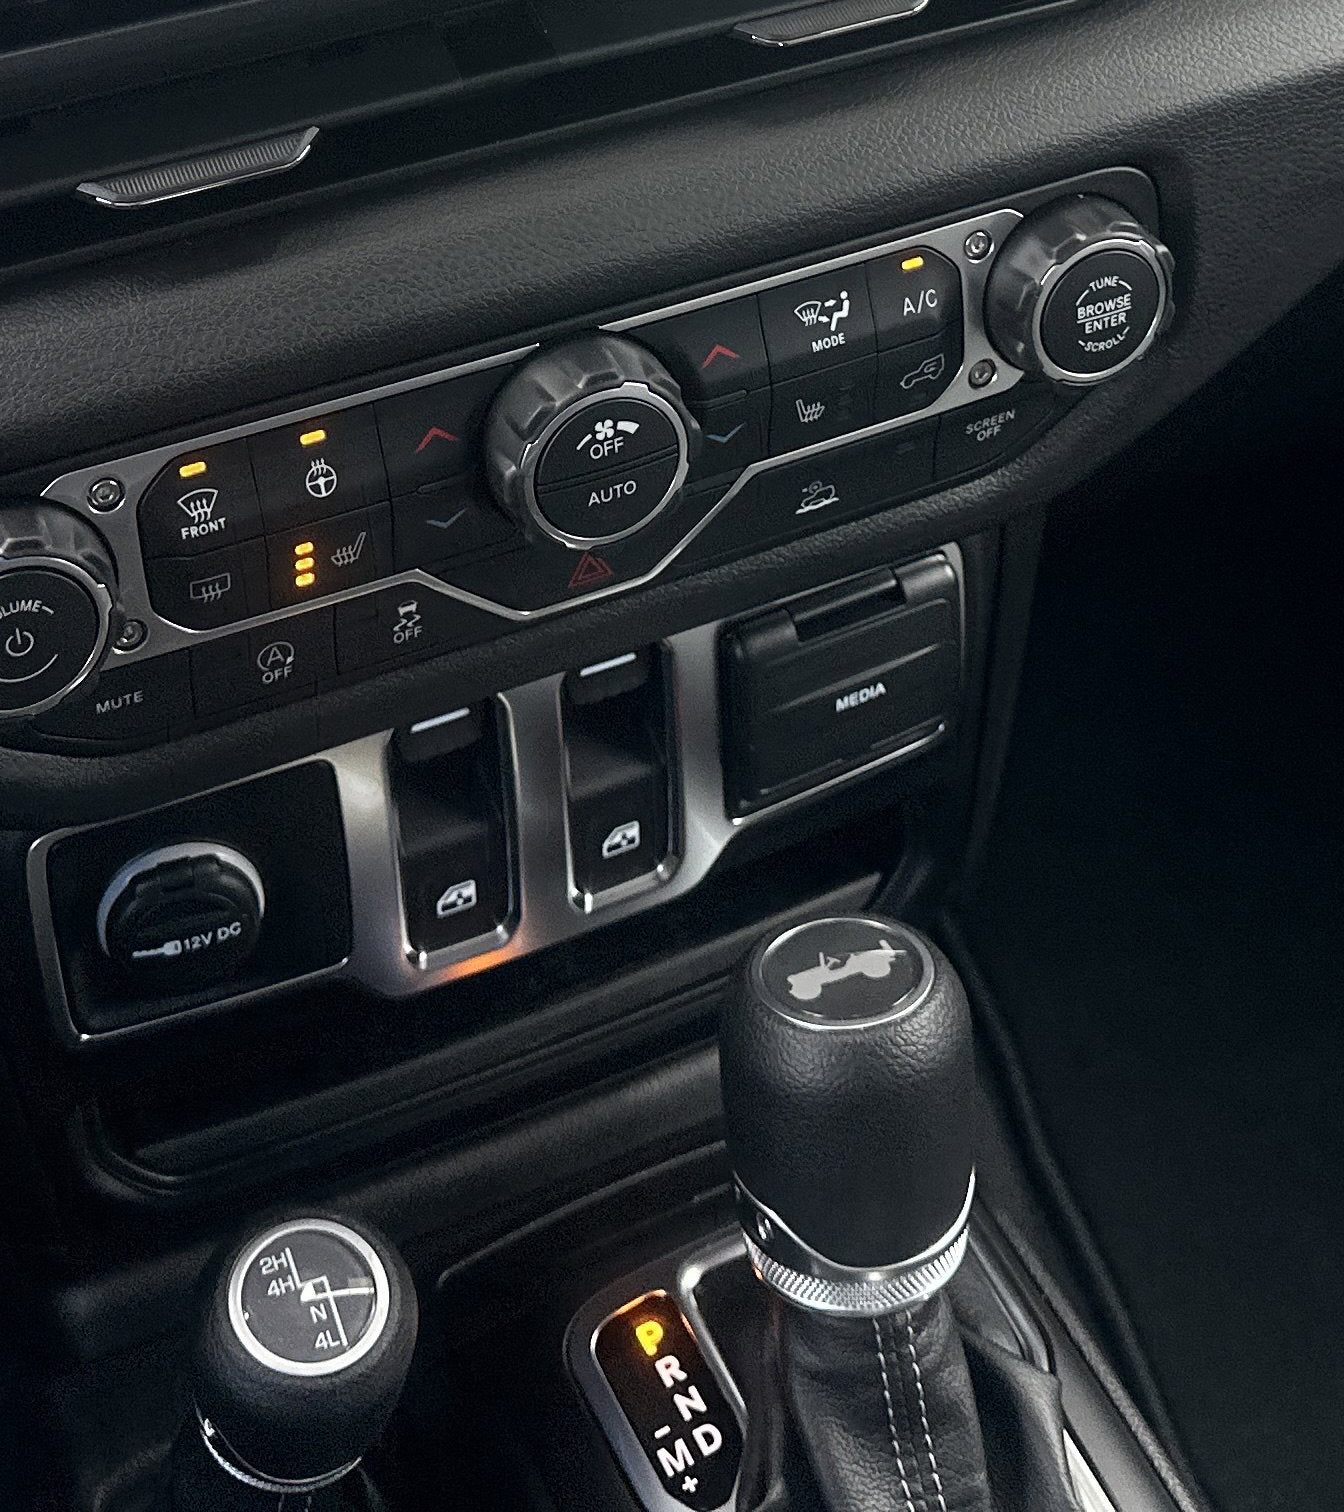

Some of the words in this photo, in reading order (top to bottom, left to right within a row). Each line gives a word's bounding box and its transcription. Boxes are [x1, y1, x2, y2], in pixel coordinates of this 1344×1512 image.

[1089, 274, 1118, 293] TUNE
[902, 288, 938, 317] A/C
[1076, 294, 1132, 322] BROWSE
[1084, 312, 1127, 333] ENTER
[811, 332, 846, 353] MODE
[1083, 334, 1124, 353] SCROLL
[965, 407, 1016, 435] SCREEN
[976, 423, 1002, 443] OFF
[589, 436, 624, 459] OFF
[587, 480, 637, 507] AUTO
[180, 516, 226, 539] FRONT
[392, 624, 423, 645] OFF
[261, 665, 292, 684] OFF
[95, 690, 144, 714] MUTE
[835, 684, 886, 712] MEDIA
[183, 930, 214, 952] 12V
[217, 920, 243, 943] DC
[259, 1252, 289, 1275] 2H
[267, 1277, 296, 1298] 4H
[310, 1303, 327, 1323] N
[314, 1329, 340, 1351] 4L
[635, 1321, 665, 1356] P
[655, 1355, 687, 1388] R
[672, 1385, 708, 1422] N
[693, 1422, 725, 1457] D
[656, 1437, 695, 1479] M
